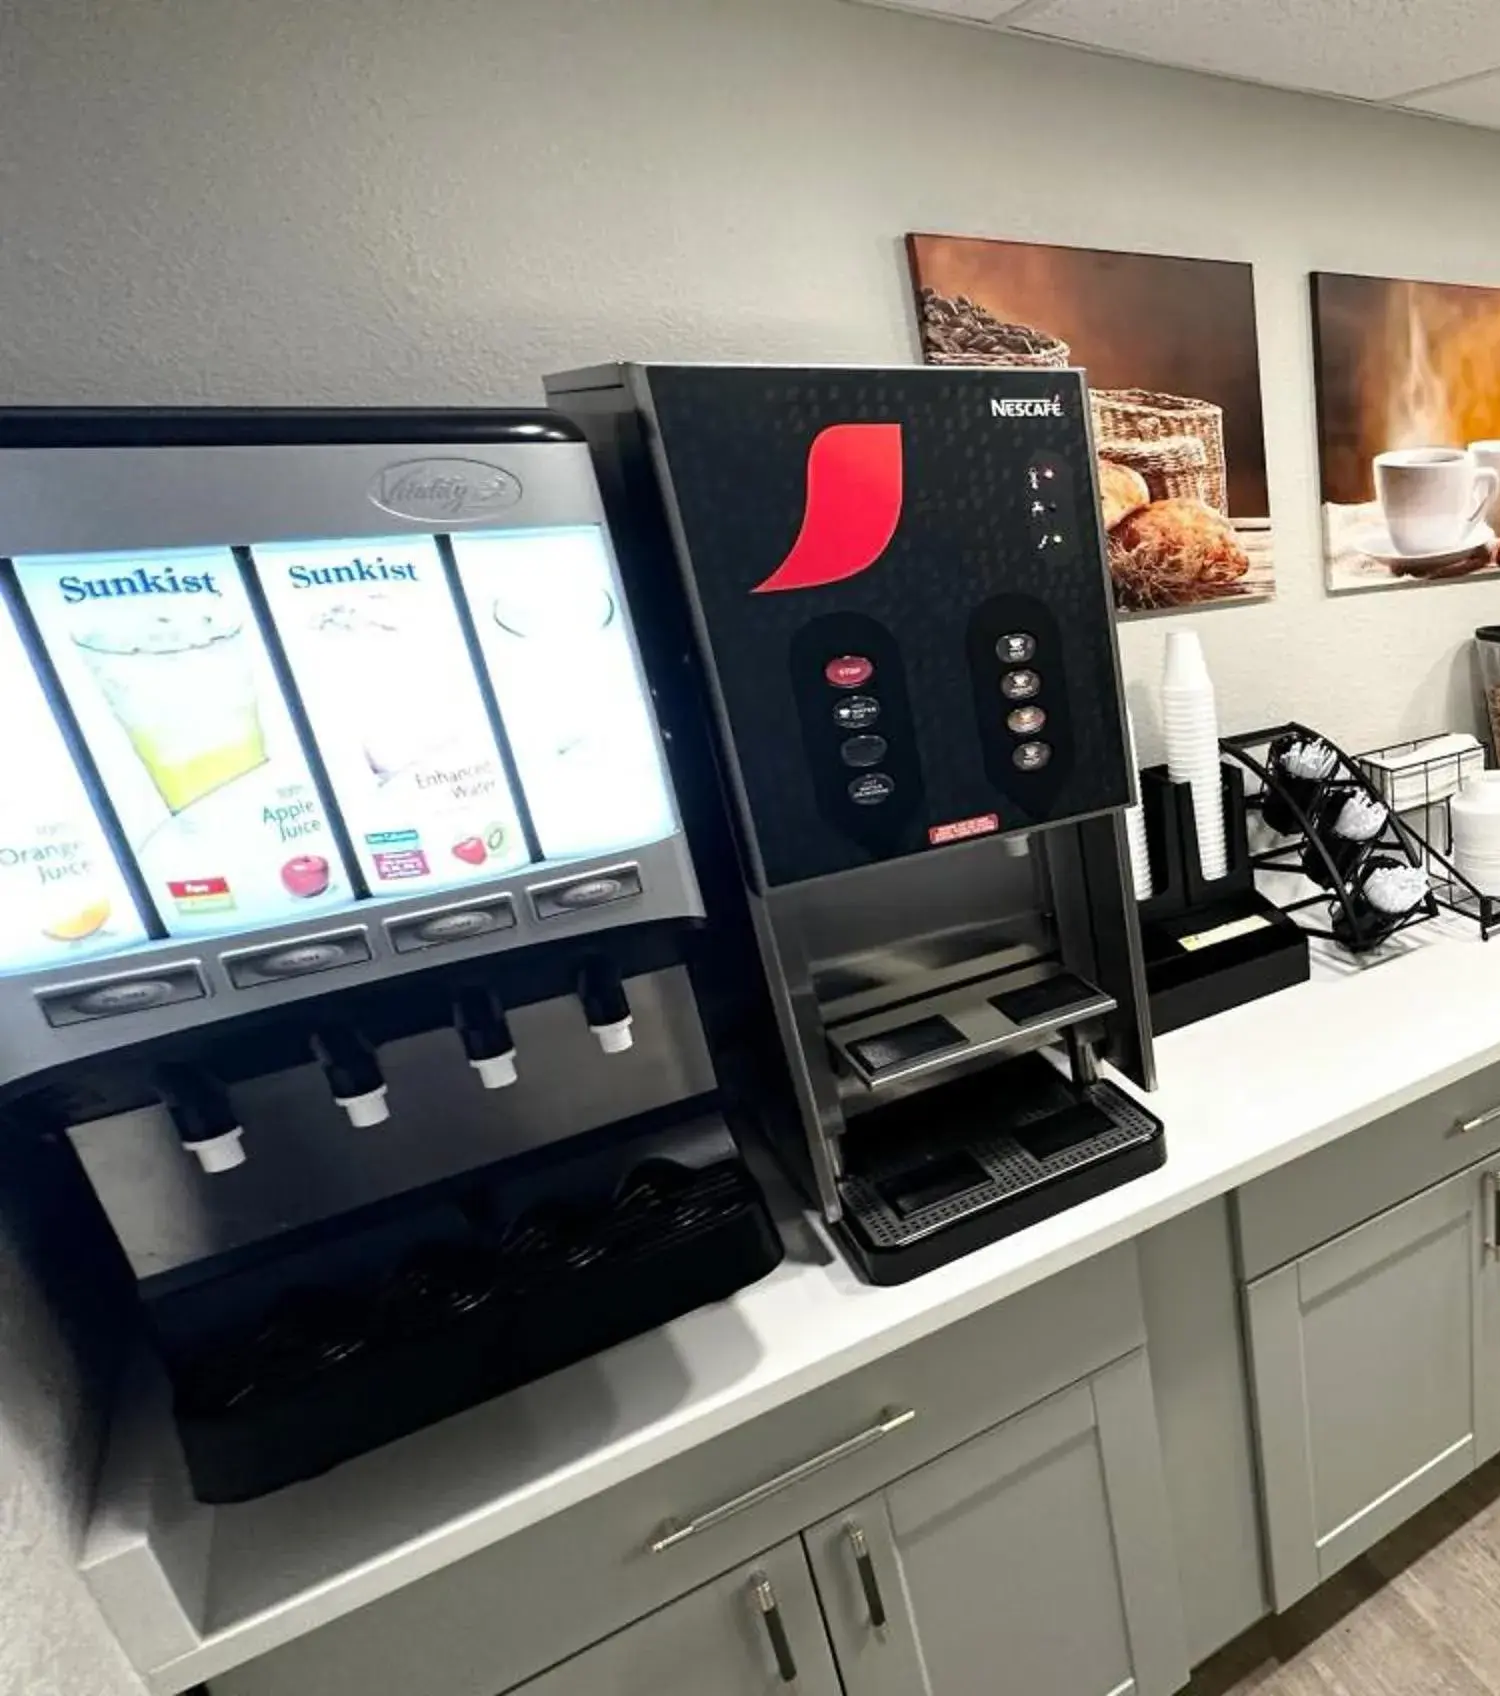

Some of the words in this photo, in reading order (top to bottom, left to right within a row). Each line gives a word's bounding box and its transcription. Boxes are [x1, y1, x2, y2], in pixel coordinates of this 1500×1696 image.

[990, 394, 1065, 417] NESCAFÉ
[58, 566, 217, 604] Sunkist
[288, 557, 419, 589] Sunkist
[263, 799, 315, 825] Apple
[280, 819, 321, 842] Juice
